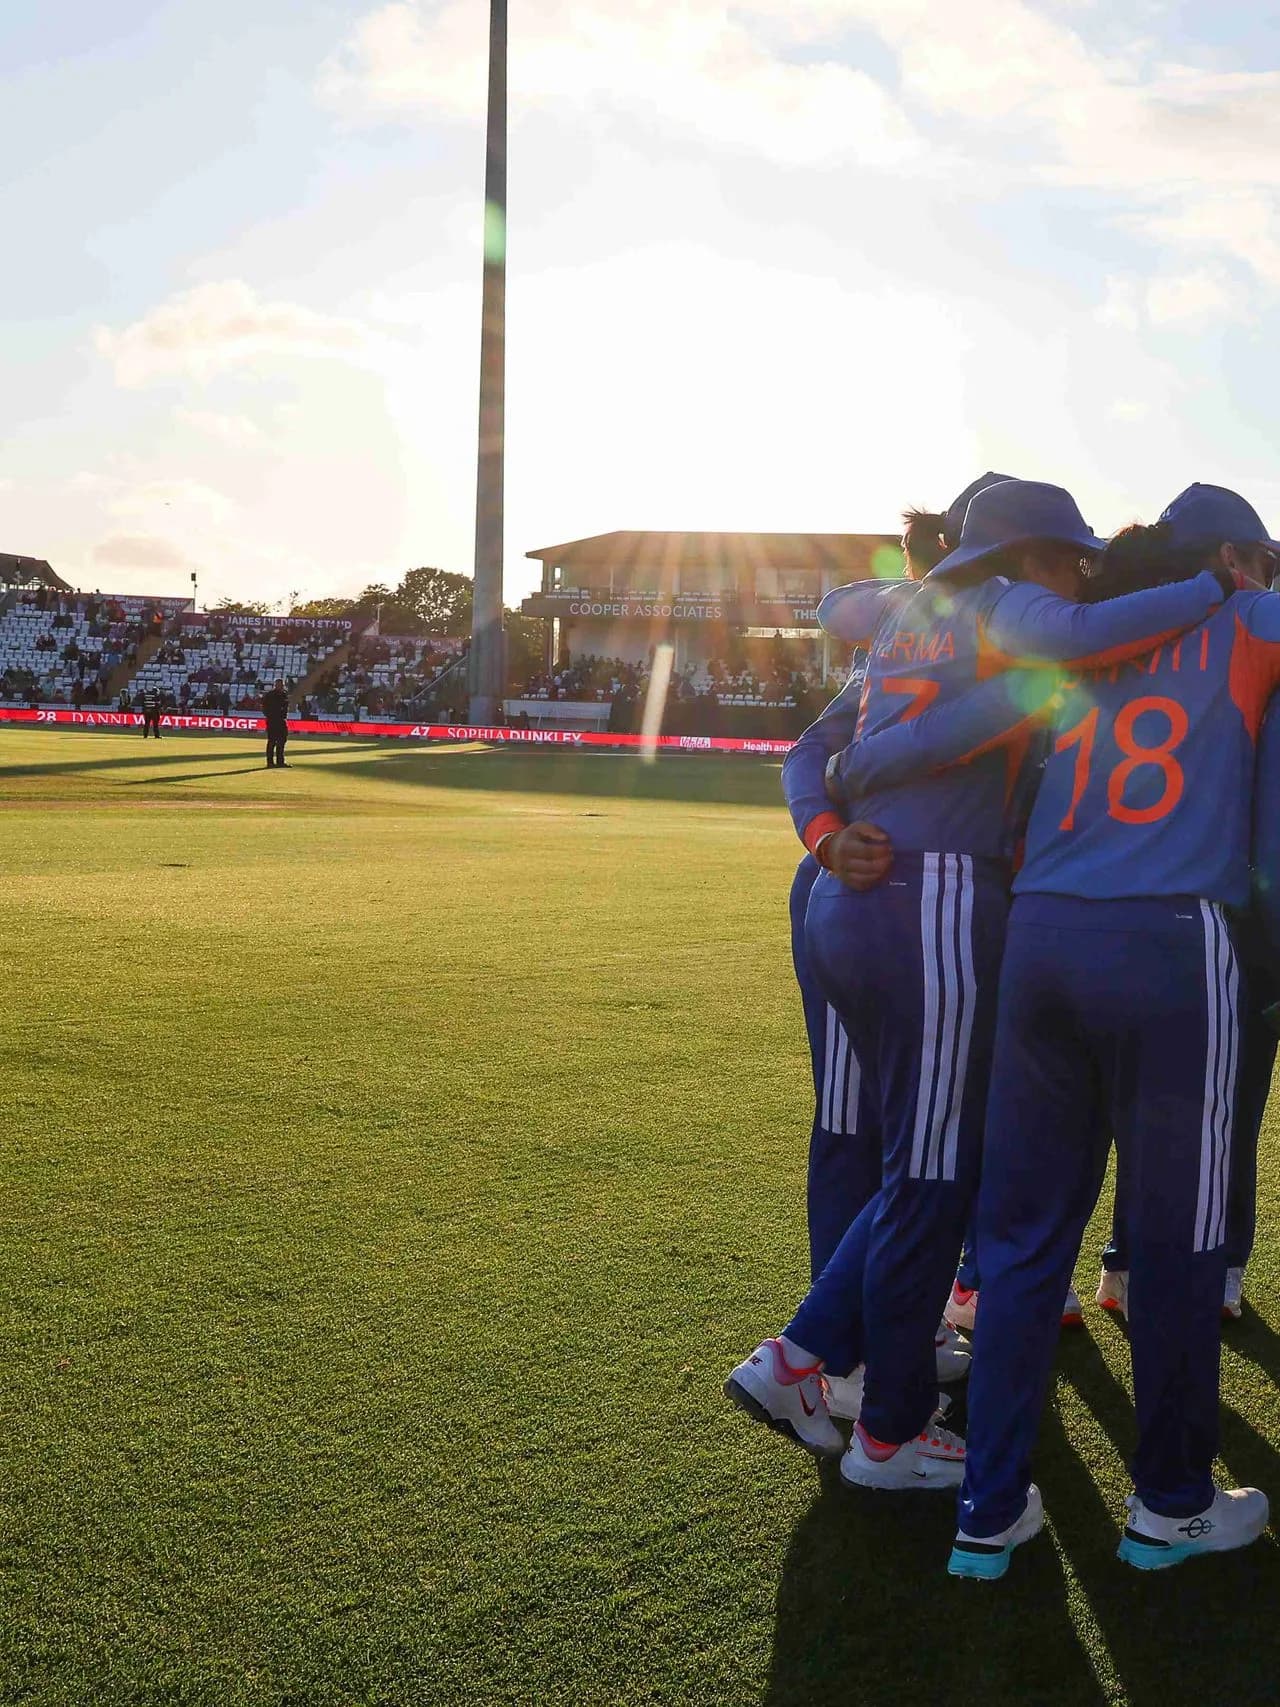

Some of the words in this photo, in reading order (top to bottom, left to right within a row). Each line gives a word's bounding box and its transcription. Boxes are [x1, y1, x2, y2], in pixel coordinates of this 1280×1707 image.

[569, 603, 629, 616] COOPER
[634, 604, 722, 619] ASSOCIATES
[793, 608, 817, 620] THE
[228, 616, 261, 626] JAMES
[36, 711, 57, 721] 28
[72, 713, 128, 725] DANNI
[133, 714, 258, 729] WATT-HODGE
[411, 726, 430, 736] 47
[448, 728, 505, 739] SOPHIA
[744, 742, 772, 752] Health
[1054, 696, 1189, 832] 18
